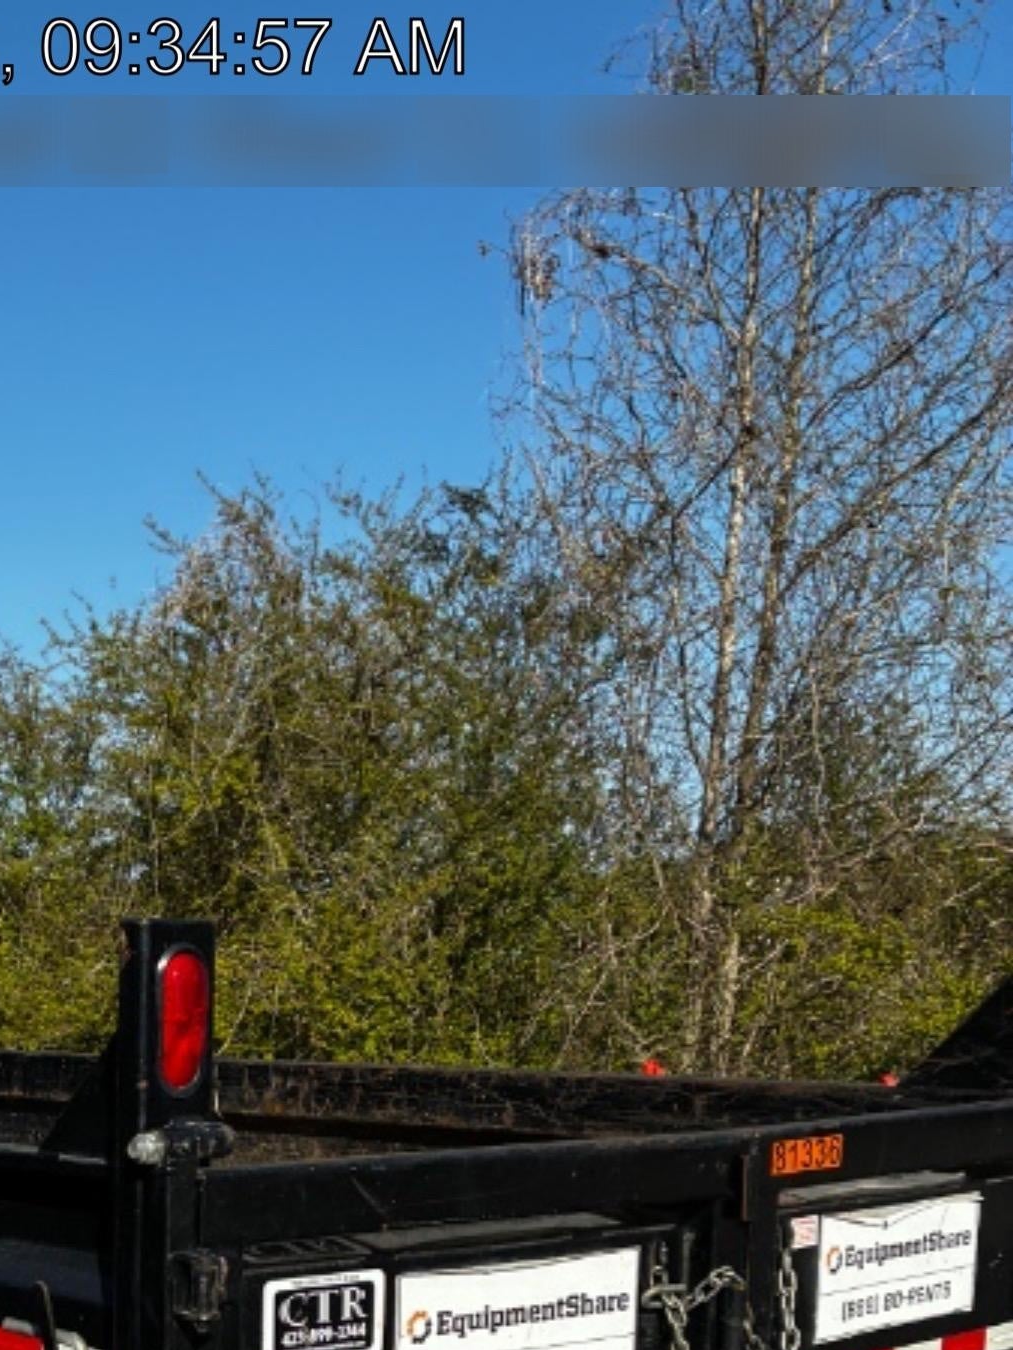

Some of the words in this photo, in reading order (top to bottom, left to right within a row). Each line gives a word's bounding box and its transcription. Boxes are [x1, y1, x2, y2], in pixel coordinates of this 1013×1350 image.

[775, 1136, 842, 1171] 81336
[845, 1229, 972, 1269] EquipmentShare
[278, 1285, 369, 1328] CTR
[436, 1291, 630, 1339] EquipmentShare
